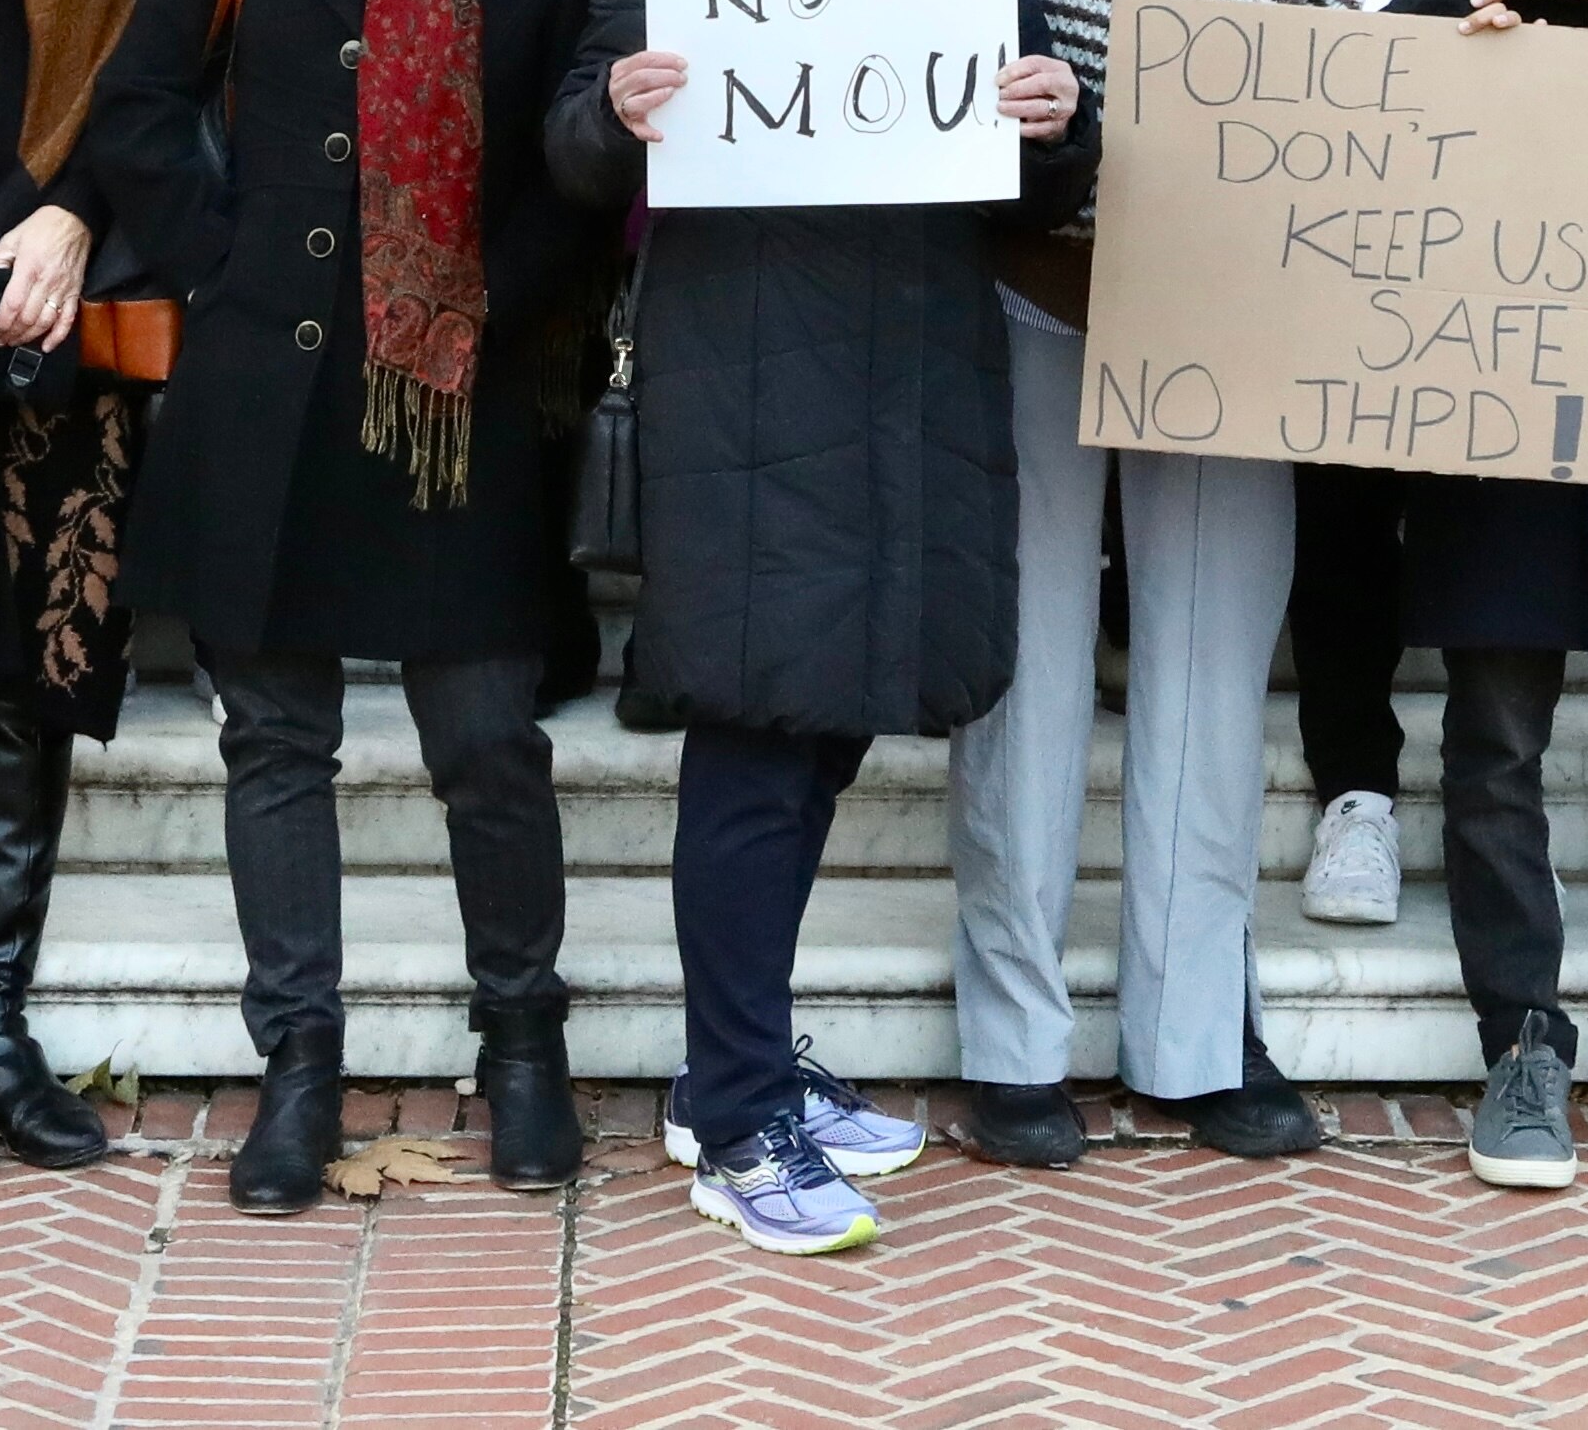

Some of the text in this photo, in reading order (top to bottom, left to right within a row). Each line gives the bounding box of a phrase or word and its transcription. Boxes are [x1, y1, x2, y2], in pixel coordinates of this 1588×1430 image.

[1134, 5, 1425, 125] POLICE
[1217, 121, 1477, 183] DON'T
[1281, 203, 1588, 293] KEEP US
[1357, 289, 1569, 387] SAFE
[1095, 359, 1223, 442] NO
